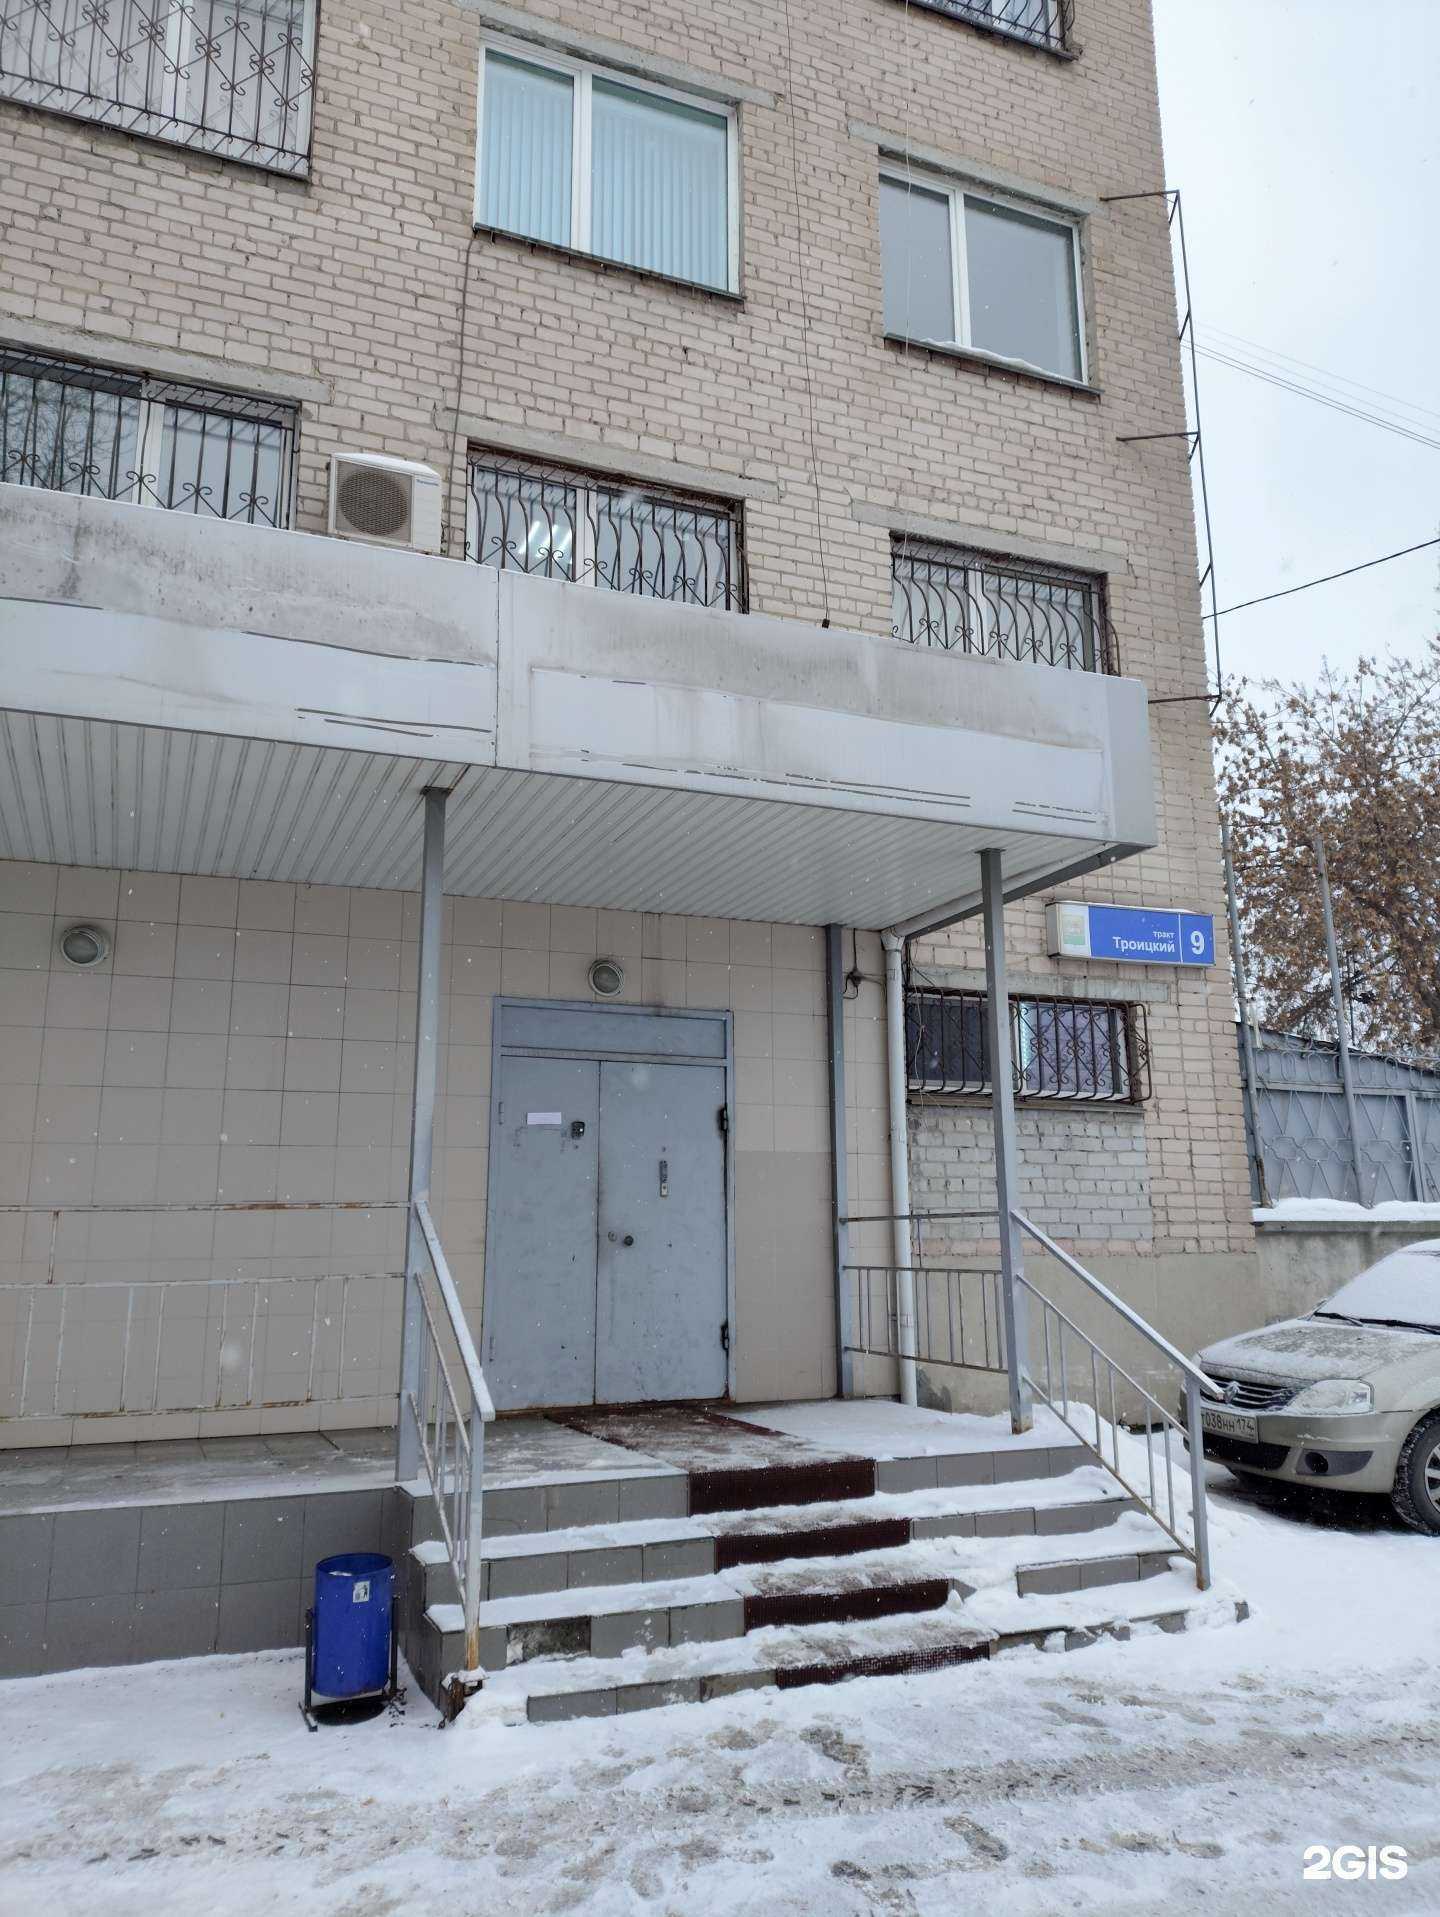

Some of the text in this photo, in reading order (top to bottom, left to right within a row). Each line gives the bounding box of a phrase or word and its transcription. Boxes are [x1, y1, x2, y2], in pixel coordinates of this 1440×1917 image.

[1152, 931, 1175, 940] тракт
[1190, 930, 1205, 955] 9
[1112, 936, 1176, 953] Троицкий
